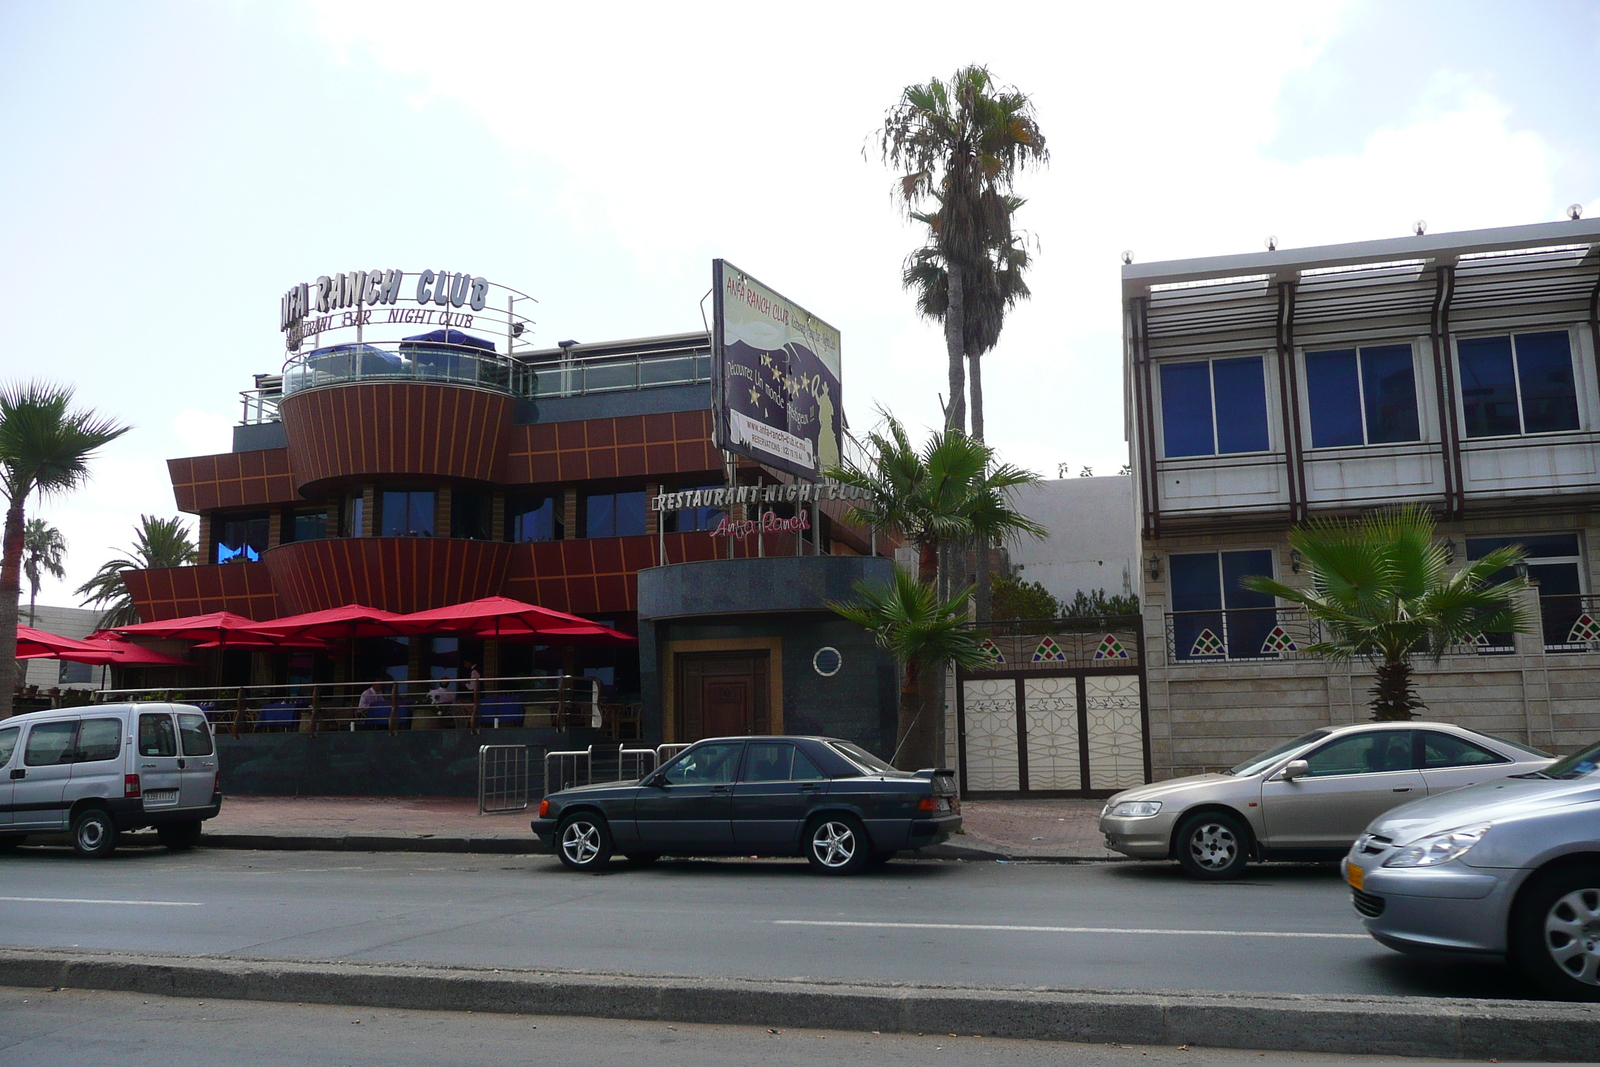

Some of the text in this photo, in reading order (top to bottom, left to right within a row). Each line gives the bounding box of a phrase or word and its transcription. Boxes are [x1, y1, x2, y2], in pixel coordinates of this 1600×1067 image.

[315, 268, 403, 314] RANCH
[417, 268, 489, 312] CLUB
[726, 277, 789, 326] ANFA RANCH CLUB
[343, 310, 372, 326] BAR
[388, 308, 435, 324] NIGHT
[438, 311, 474, 328] CLUB
[727, 360, 753, 380] Découvrez
[765, 385, 785, 409] monde
[658, 485, 760, 511] RESTAURANT
[764, 484, 823, 502] NIGHT
